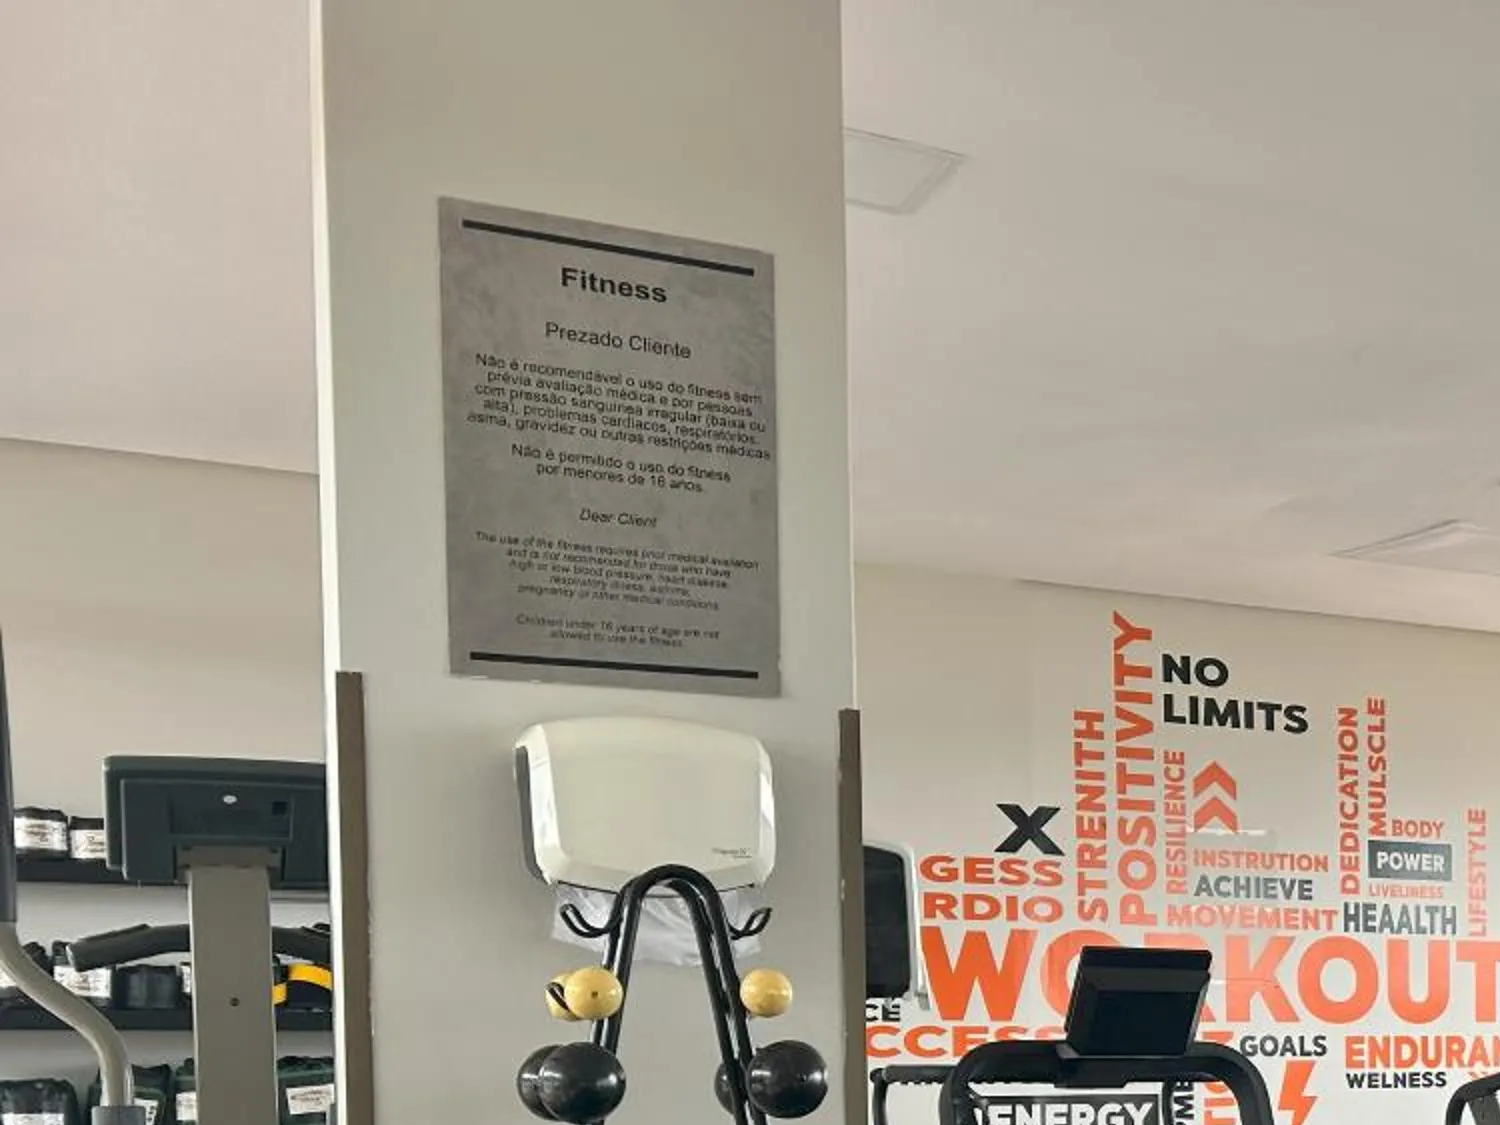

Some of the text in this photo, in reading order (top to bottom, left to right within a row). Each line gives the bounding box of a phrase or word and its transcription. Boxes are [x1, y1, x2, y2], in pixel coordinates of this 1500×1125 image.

[560, 266, 667, 303] Fitness
[545, 320, 691, 359] Prezado Cliente
[475, 352, 505, 368] Não
[509, 357, 518, 370] é
[523, 360, 621, 384] recomendável
[625, 376, 634, 386] o
[638, 378, 662, 390] uso
[667, 381, 684, 393] do
[687, 383, 729, 399] fitness
[474, 384, 504, 397] com
[509, 387, 566, 407] pressão
[647, 405, 700, 426] irregular
[705, 413, 744, 432] (baixa
[749, 420, 765, 432] ou
[487, 369, 752, 417] prévia avaliação médica e por pessoas
[523, 402, 596, 424] problemas
[515, 416, 576, 437] gravidez
[579, 426, 596, 437] ou
[601, 428, 643, 444] outras
[647, 433, 712, 455] restrições
[511, 443, 730, 482] Não é permitido o uso do fitness
[536, 462, 559, 477] por
[563, 465, 624, 483] menores
[627, 471, 644, 486] de
[579, 507, 656, 528] Dear Client
[475, 530, 496, 542] The
[499, 535, 518, 545] use
[1162, 653, 1229, 687] NO
[1163, 694, 1309, 734] LIMITS
[1113, 610, 1157, 926] POSITIVITY
[1367, 697, 1387, 838] MULSCLE
[1073, 709, 1109, 924] STRENITH
[1337, 706, 1361, 895] DEDICATION
[1163, 750, 1188, 895] RESILIENCE
[1391, 819, 1444, 838] BODY
[919, 854, 1063, 887] GESS
[1193, 848, 1328, 873] INSTRUTION
[1377, 851, 1445, 872] POWER
[1468, 808, 1487, 937] LIFESTYLE
[1194, 874, 1313, 901] ACHIEVE
[922, 891, 1064, 922] RDIO
[1167, 903, 1338, 931] MOVEMENT
[1343, 902, 1457, 935] HEAALTH
[866, 1025, 1066, 1057] CCE
[1240, 1035, 1327, 1057] GOALS
[1346, 1072, 1447, 1089] WELNESS
